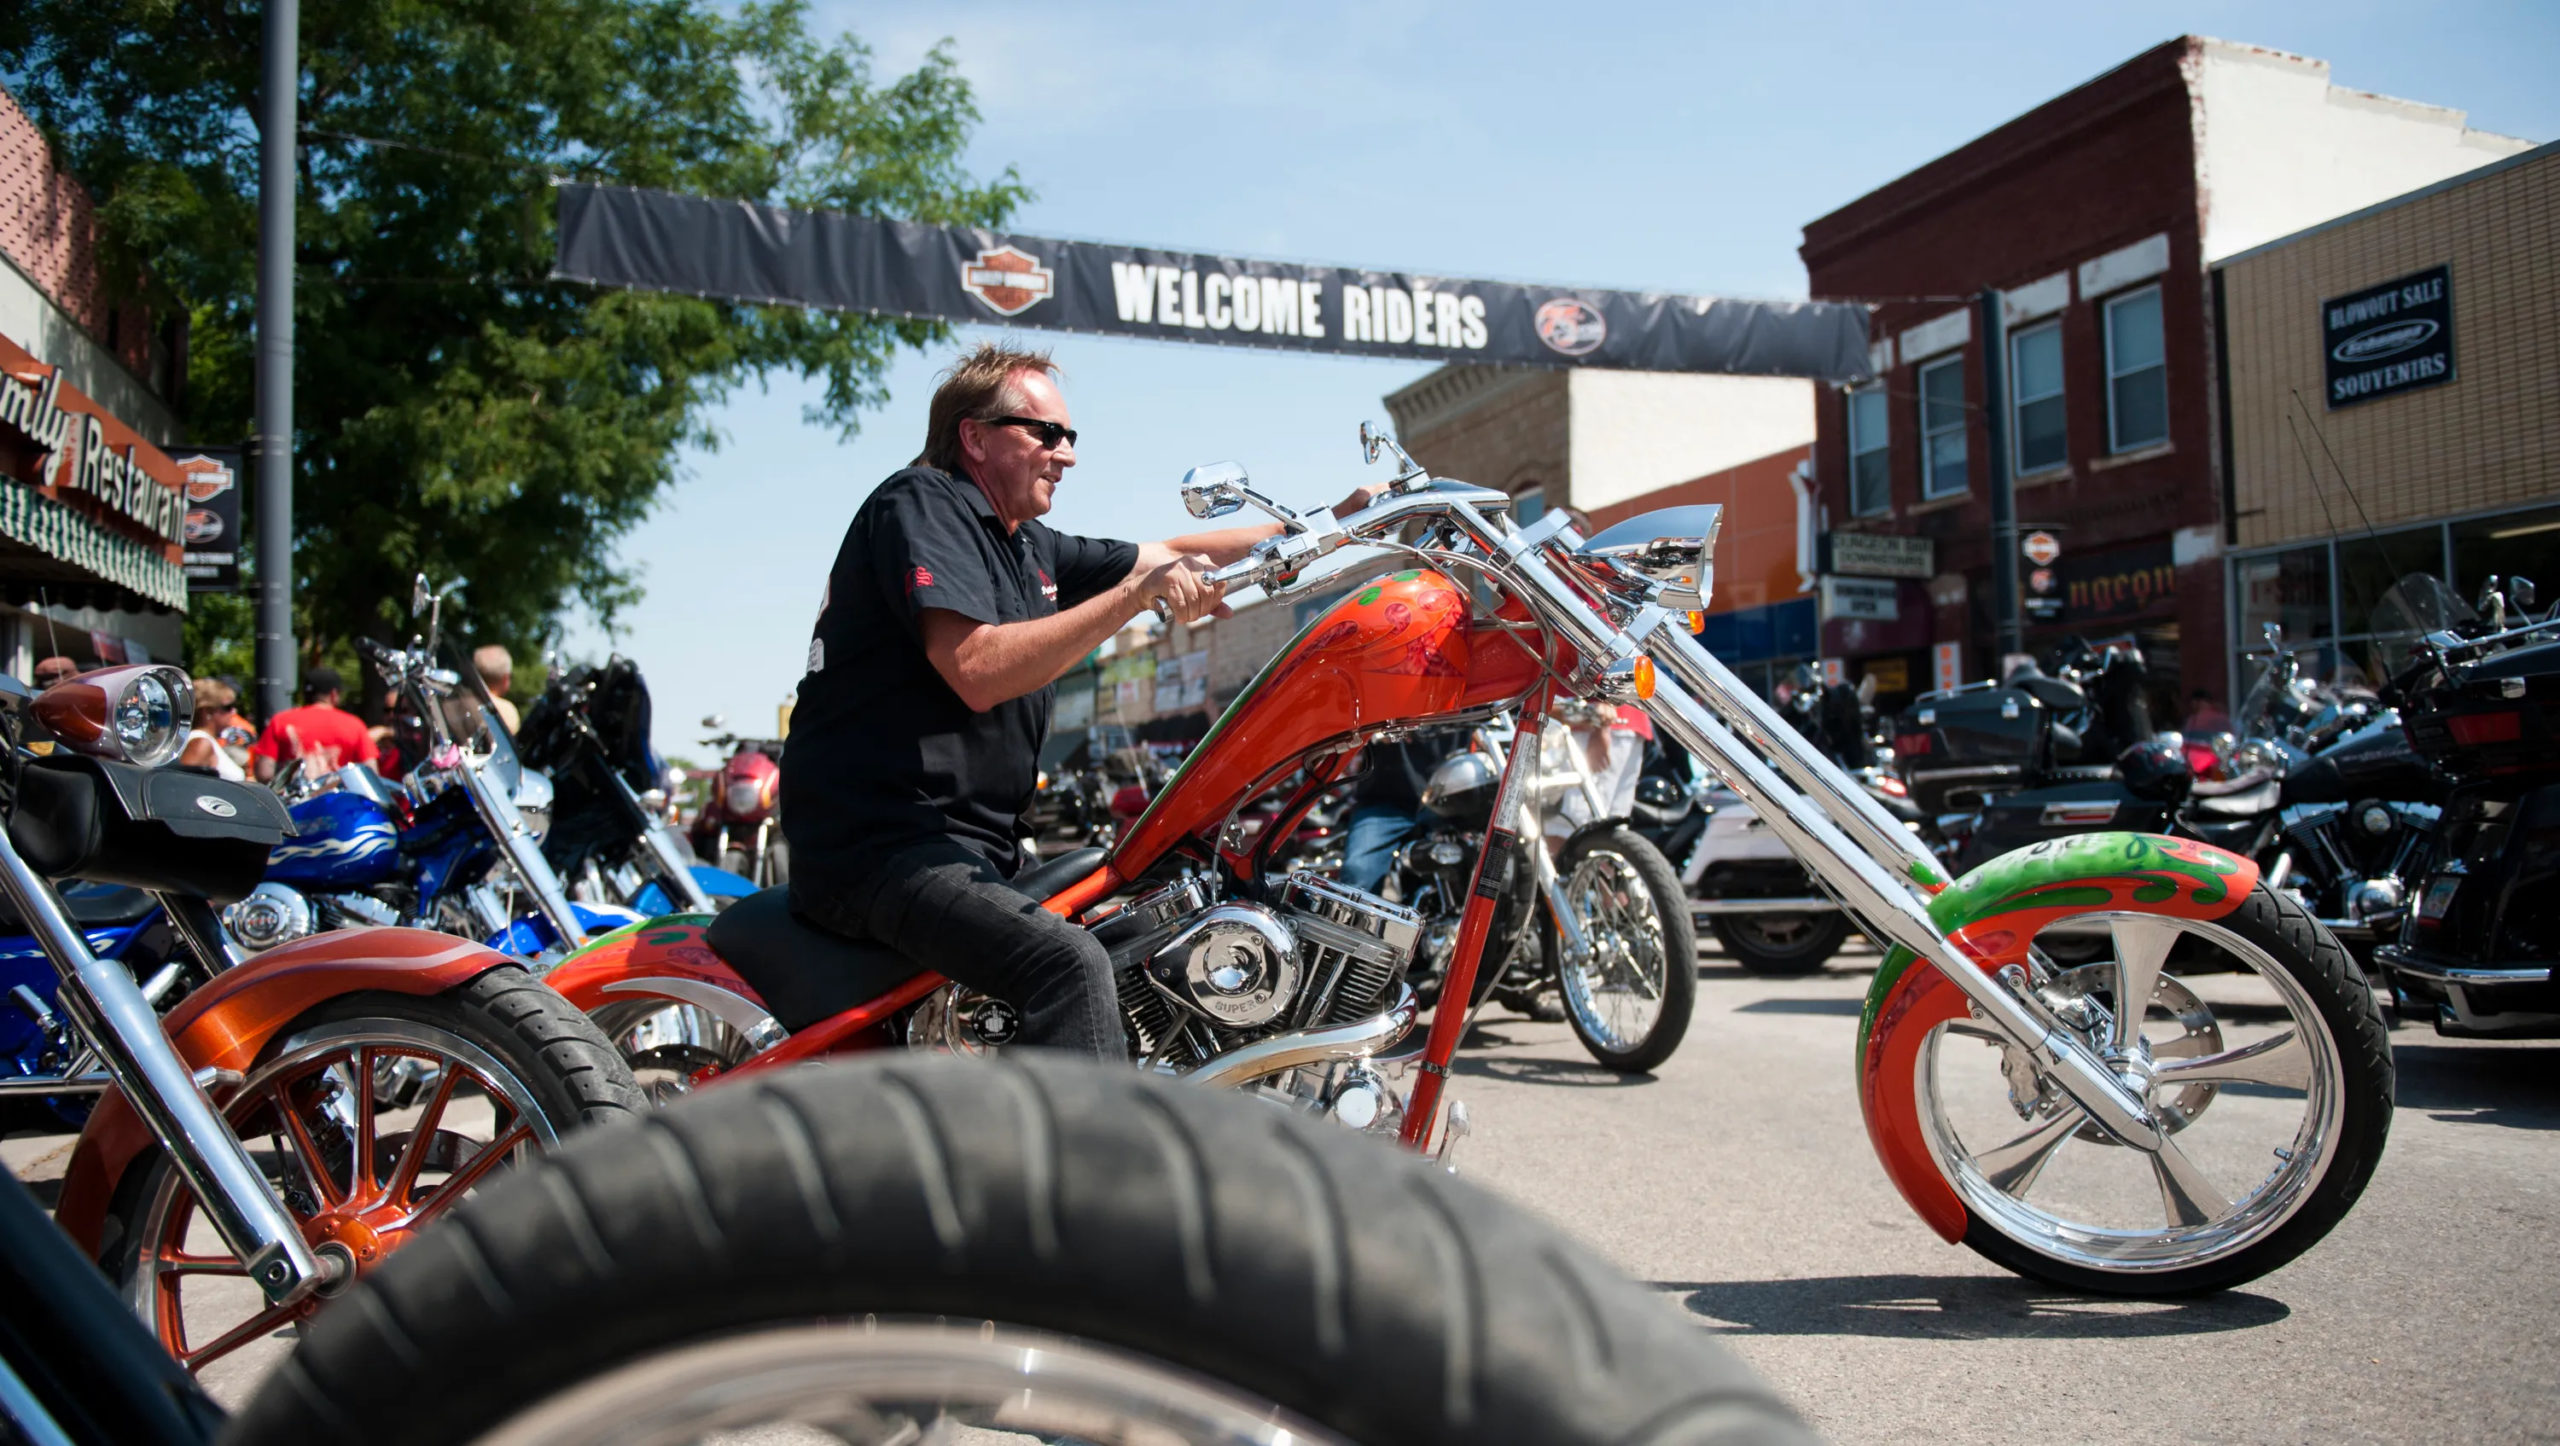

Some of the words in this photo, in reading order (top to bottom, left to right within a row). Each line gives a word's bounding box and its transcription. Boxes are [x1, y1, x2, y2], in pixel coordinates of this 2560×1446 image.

[1111, 261, 1325, 336] WELCOME
[1344, 284, 1488, 349] RIDERS
[2330, 291, 2399, 329] BLOWOUT
[2402, 277, 2443, 309] SALE
[2333, 353, 2446, 399] SOUVENIRS
[0, 366, 70, 487] mily
[83, 414, 188, 545] Restaurant
[2069, 564, 2176, 612] ngeon
[1216, 1000, 1256, 1014] SUPER
